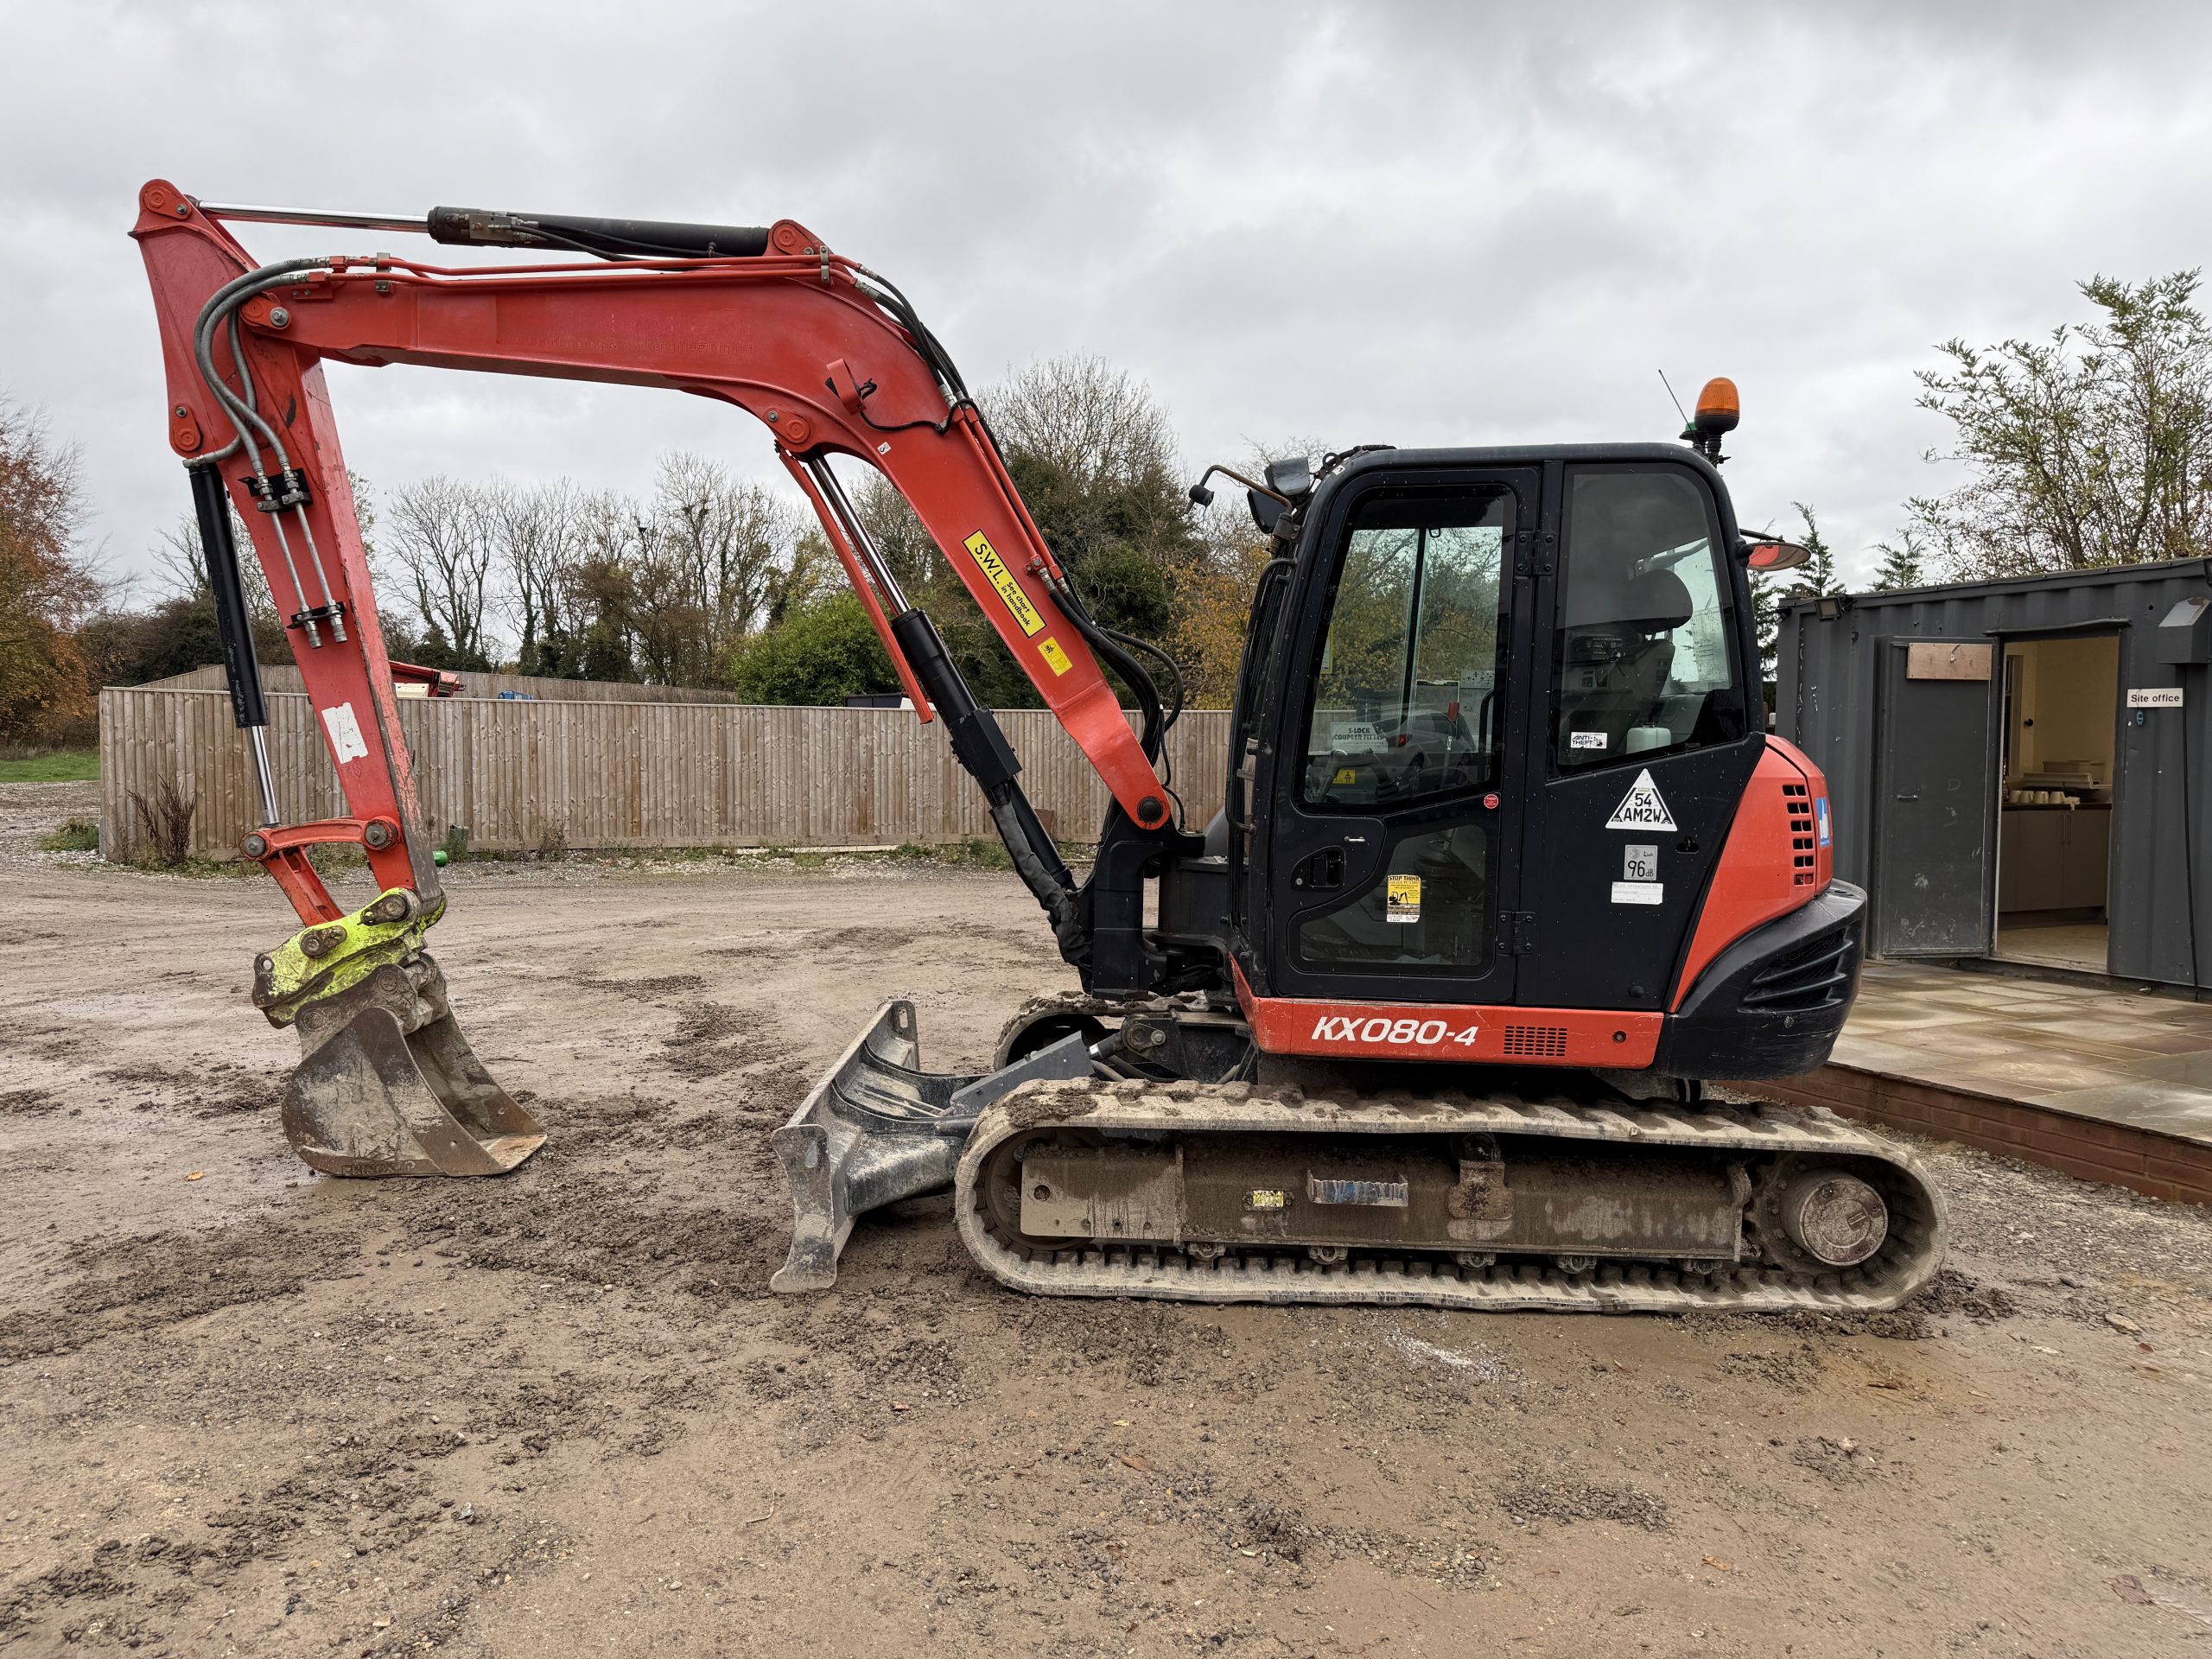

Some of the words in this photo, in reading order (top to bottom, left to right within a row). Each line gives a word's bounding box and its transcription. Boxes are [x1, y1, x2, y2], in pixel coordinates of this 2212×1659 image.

[975, 543, 1003, 584] S.W.L.
[1007, 582, 1017, 594] See
[1016, 595, 1030, 613] chart
[1007, 593, 1031, 626] handbook
[2131, 694, 2149, 702] Site
[2152, 694, 2180, 702] office
[1635, 792, 1652, 807] 54
[1624, 807, 1662, 823] AM2W
[1628, 861, 1645, 877] 96
[1311, 1016, 1479, 1046] KX080-4
